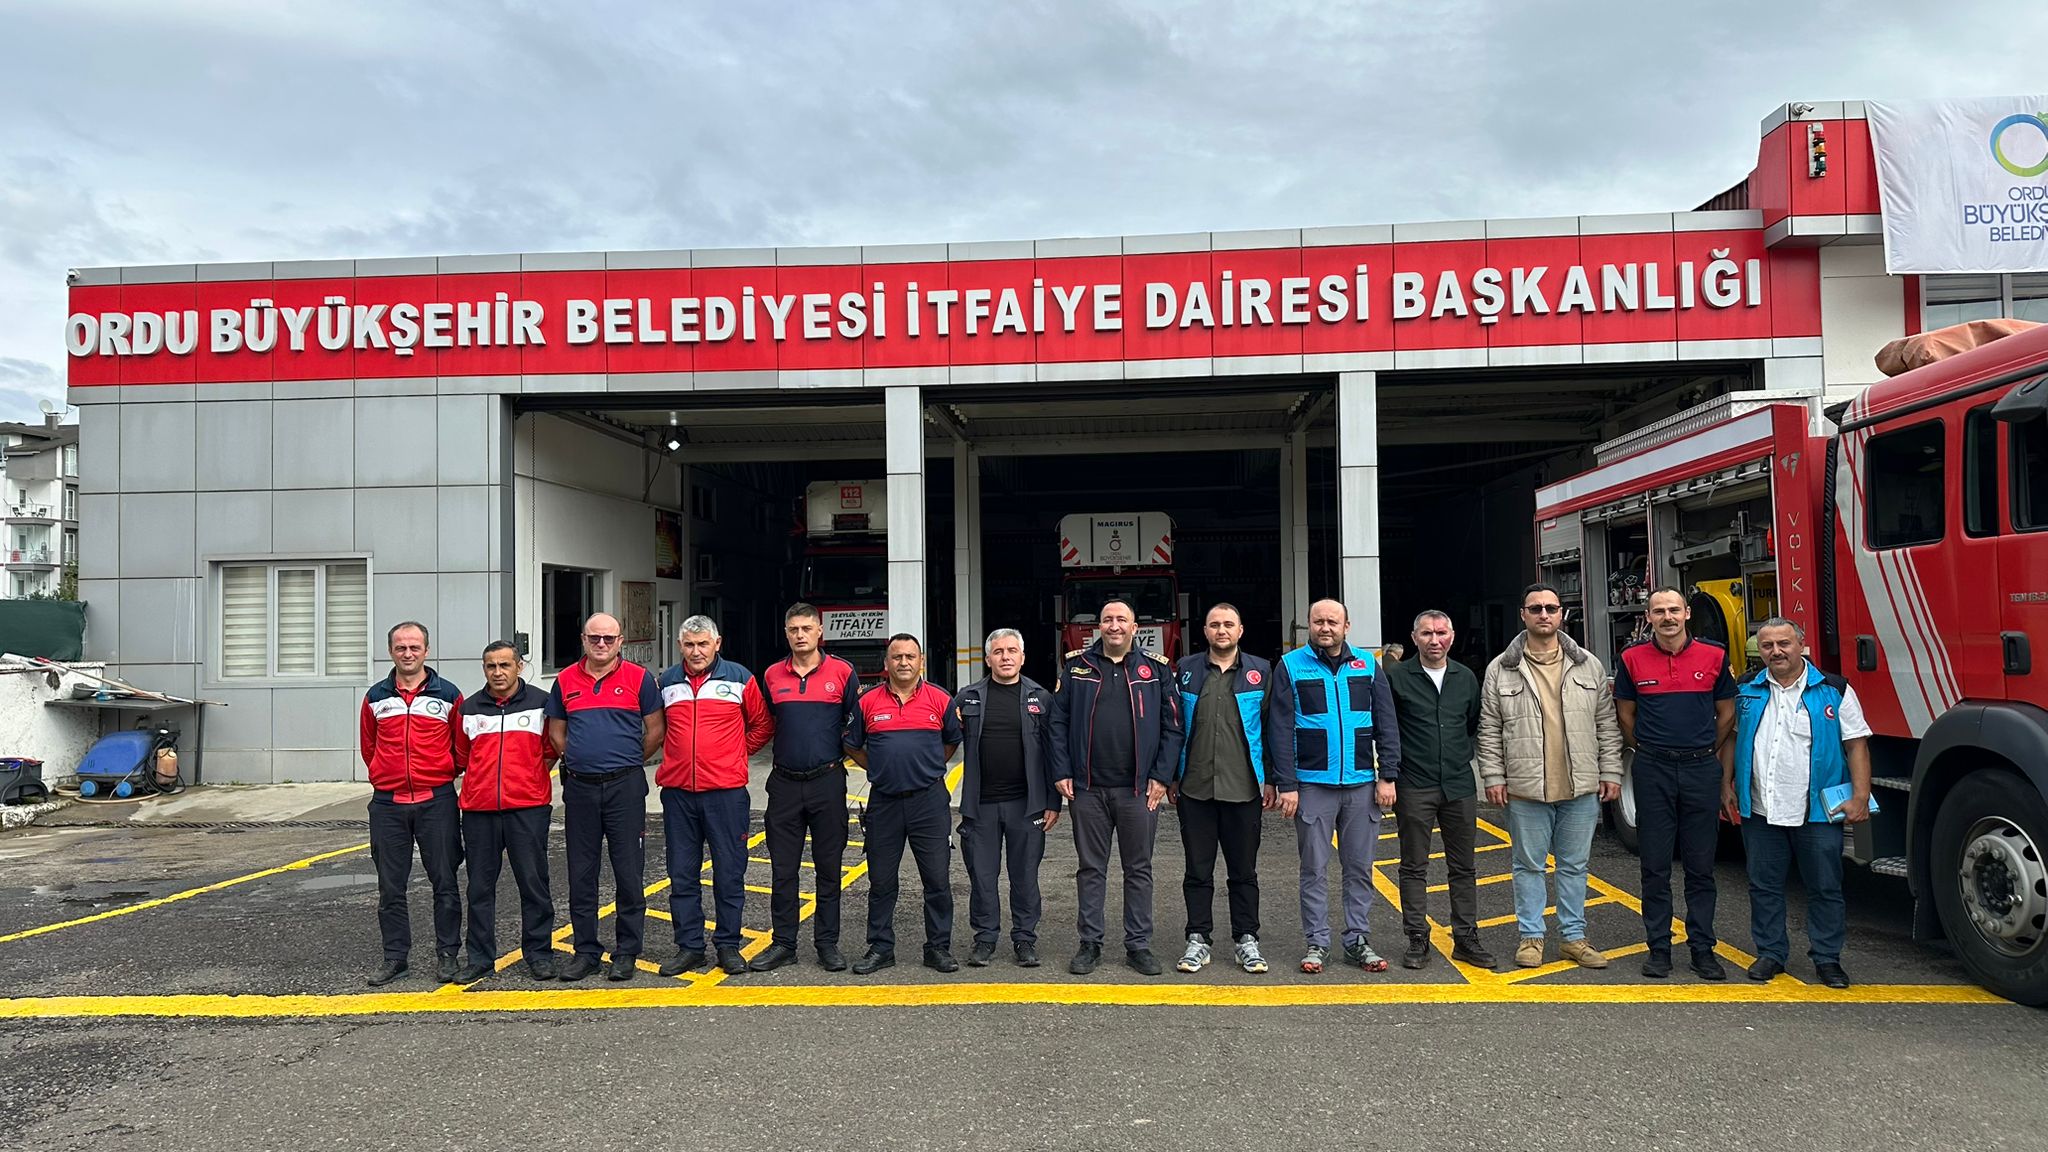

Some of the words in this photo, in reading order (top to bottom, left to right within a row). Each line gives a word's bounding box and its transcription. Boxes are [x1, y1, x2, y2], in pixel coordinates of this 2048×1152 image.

[1990, 225, 2048, 242] BELEDİ
[66, 310, 199, 357] ORDU
[210, 292, 546, 356] BÜYÜKŞEHİR
[567, 282, 886, 344] BELEDİYESİ
[907, 278, 1123, 337] İTFAİYE
[1145, 264, 1369, 328] DAİRESİ
[1392, 248, 1761, 324] BAŞKANLIĞI
[842, 488, 860, 497] 112
